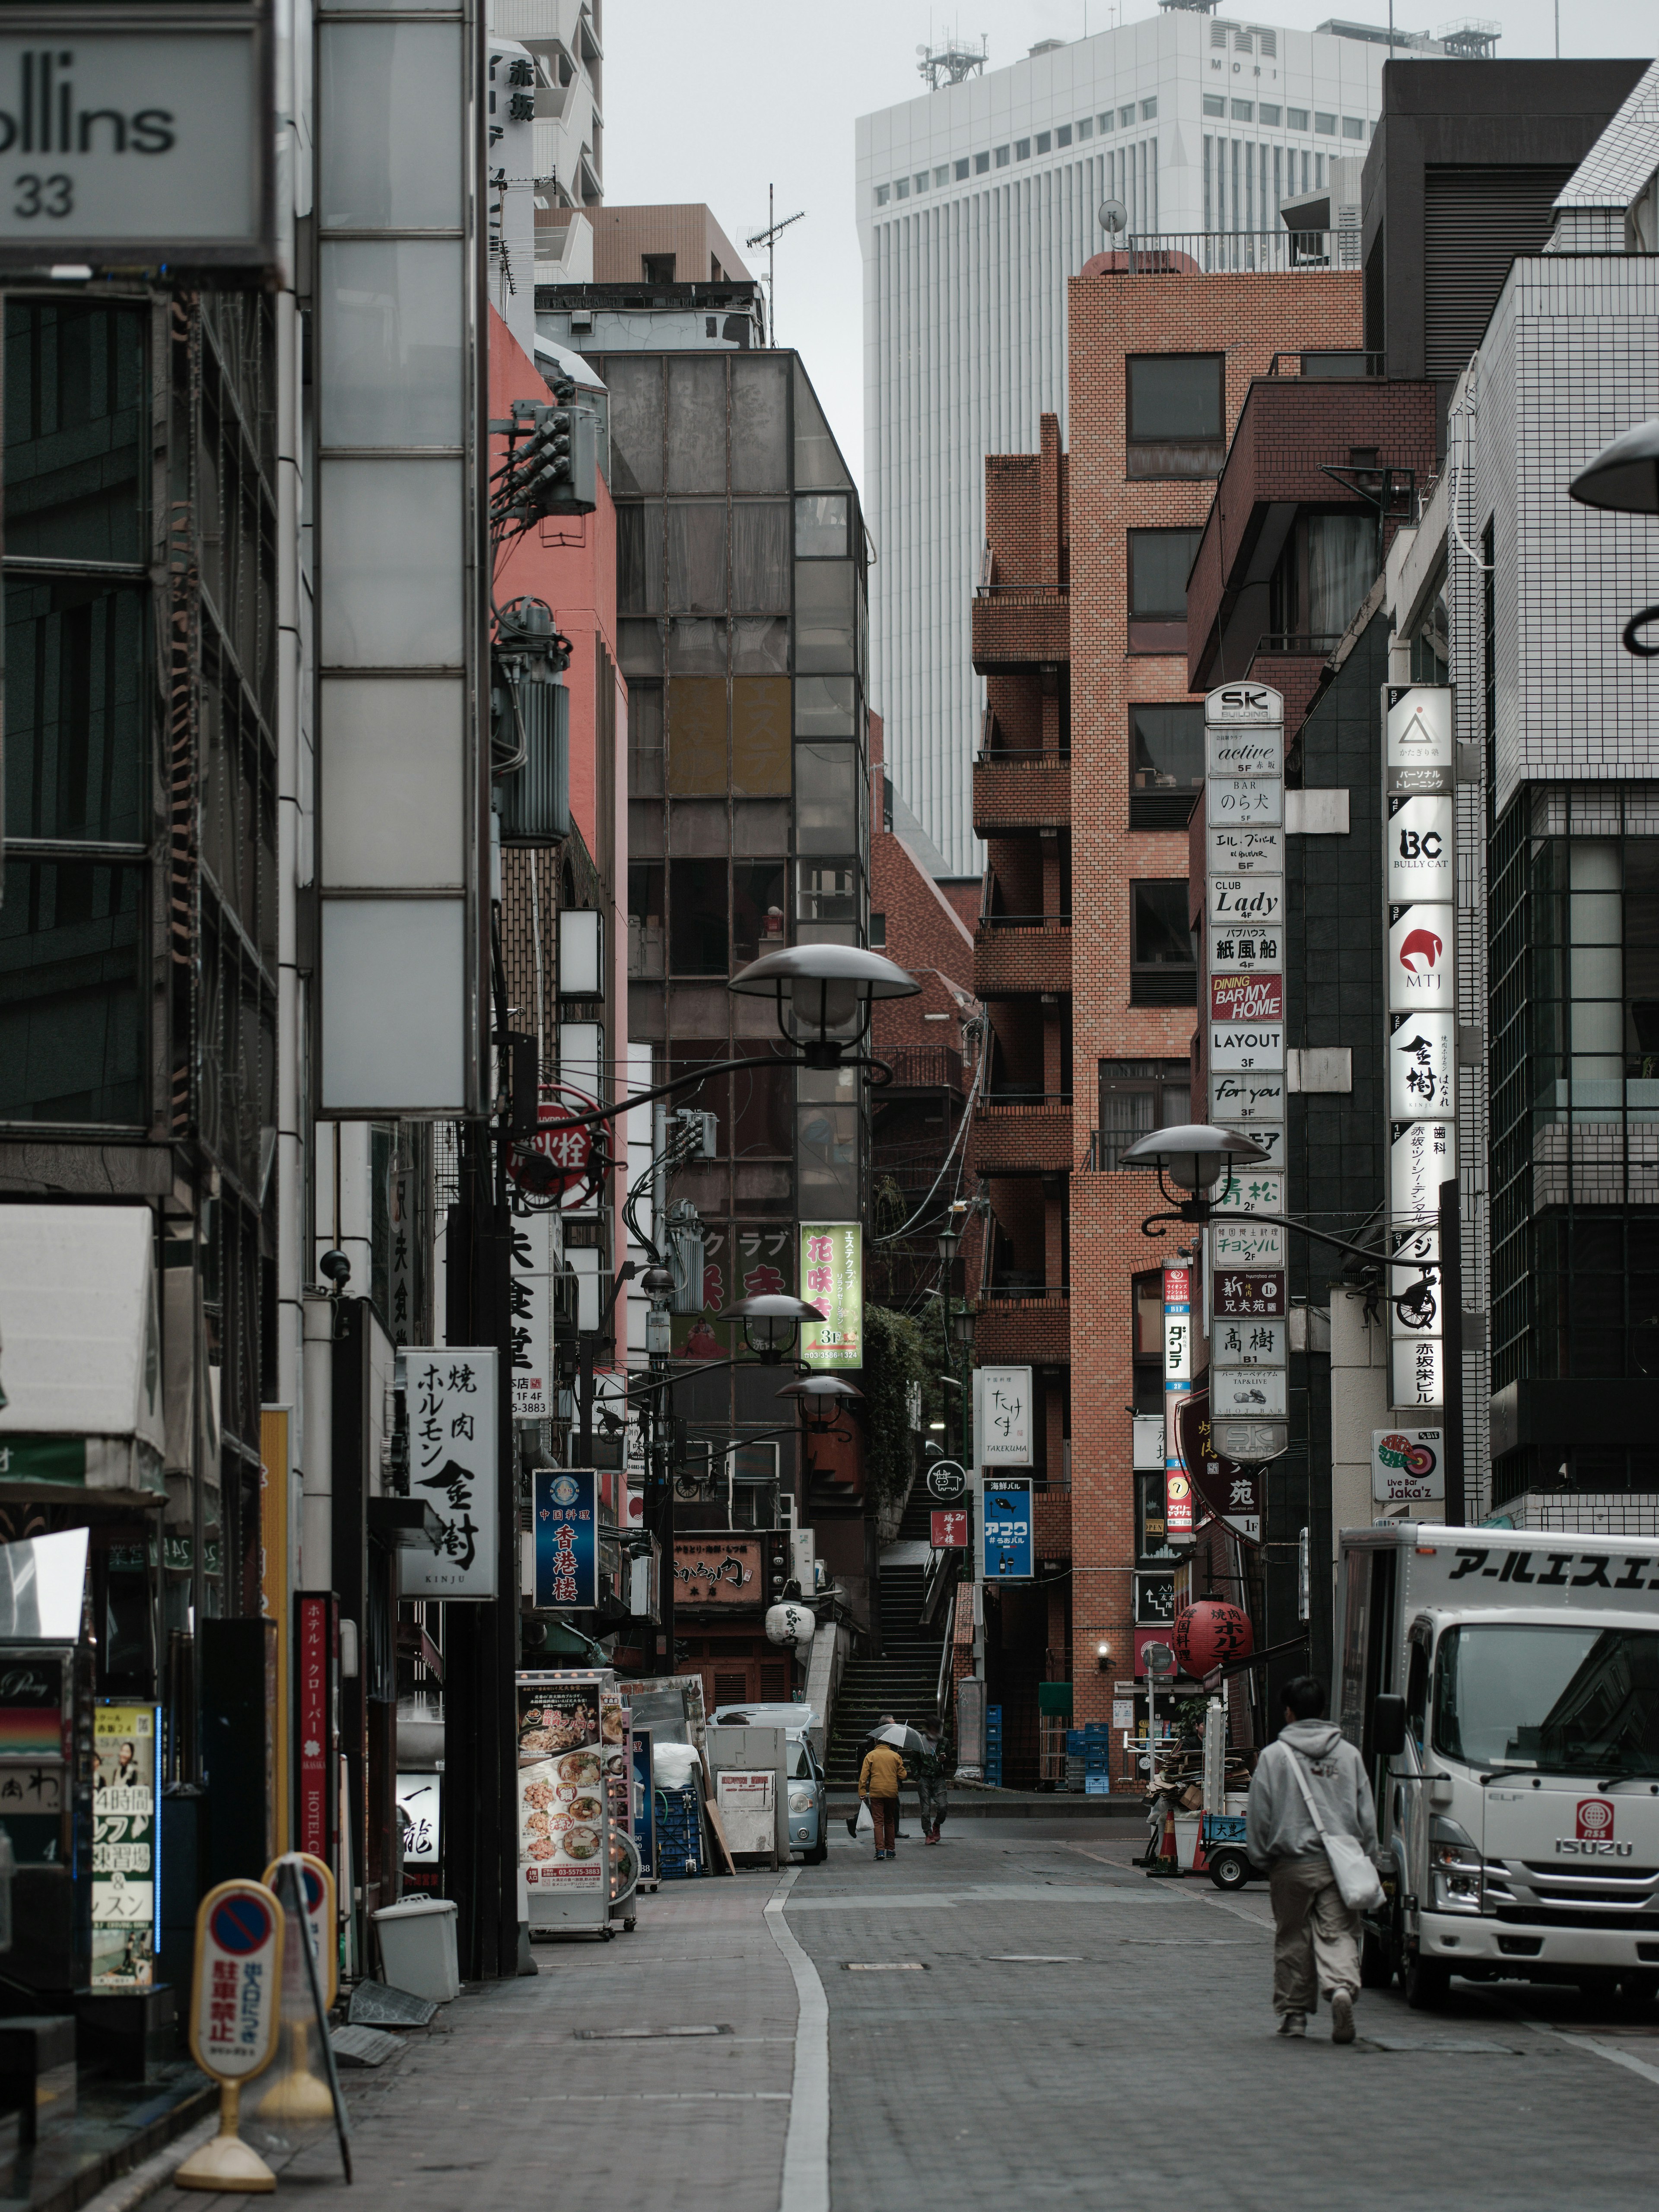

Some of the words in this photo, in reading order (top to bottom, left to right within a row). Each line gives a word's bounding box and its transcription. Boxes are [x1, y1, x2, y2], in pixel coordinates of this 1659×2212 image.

[1211, 59, 1276, 79] MORI
[510, 59, 535, 122] 赤坂
[14, 175, 73, 218] 33
[1221, 692, 1268, 710] SK
[1219, 744, 1274, 760] active
[1256, 761, 1275, 769] 赤坂
[1221, 795, 1269, 810] のら犬
[1400, 831, 1442, 859] BC
[1216, 882, 1241, 890] CLUB
[1216, 892, 1278, 916] Lady
[1227, 929, 1266, 938] パブハウス
[1217, 940, 1277, 960] 紙風船
[1214, 976, 1250, 990] DINING
[1406, 975, 1441, 990] MTJ
[1216, 989, 1244, 1004] BAR
[1244, 983, 1271, 1002] MY
[1232, 998, 1281, 1019] HOME
[1214, 1034, 1280, 1048] LAYOUT
[1241, 1059, 1254, 1068] 3F
[1396, 1035, 1437, 1101] 金樹
[1214, 1080, 1246, 1101] for
[1249, 1087, 1281, 1103] you
[1439, 1075, 1449, 1107] はなれ
[1434, 1126, 1446, 1154] 歯科
[1220, 1176, 1278, 1205] 青松
[1244, 1202, 1255, 1211] 2F
[1217, 1239, 1279, 1252] チョンソル
[845, 1231, 854, 1290] エステクラブ
[1244, 1252, 1255, 1261] 2F
[1222, 1276, 1243, 1297] 新
[1265, 1285, 1274, 1294] 1F
[1224, 1299, 1265, 1312] 兄夫苑
[821, 1330, 842, 1344] 3F
[1416, 1344, 1433, 1403] 赤坂栄ビル
[448, 1364, 477, 1441] 焼肉
[418, 1364, 444, 1467] ホルモン
[1227, 1426, 1274, 1445] SK
[1389, 1486, 1431, 1498] Jaka'z
[540, 1509, 590, 1521] 中国料理
[1244, 1519, 1258, 1532] 1F
[552, 1524, 578, 1601] 香港楼
[1449, 1548, 1659, 1590] アールエスエ
[1211, 1609, 1240, 1621] 焼肉
[1210, 1621, 1246, 1664] ホルモ
[308, 1605, 321, 1734] ホテル・クローバー
[303, 1761, 326, 1770] AKASAKA
[1488, 1793, 1524, 1802] ELF
[308, 1791, 319, 1837] HOTEL
[1584, 1830, 1605, 1838] RSS
[1555, 1838, 1633, 1856] ISUZU
[113, 1875, 124, 1890] &
